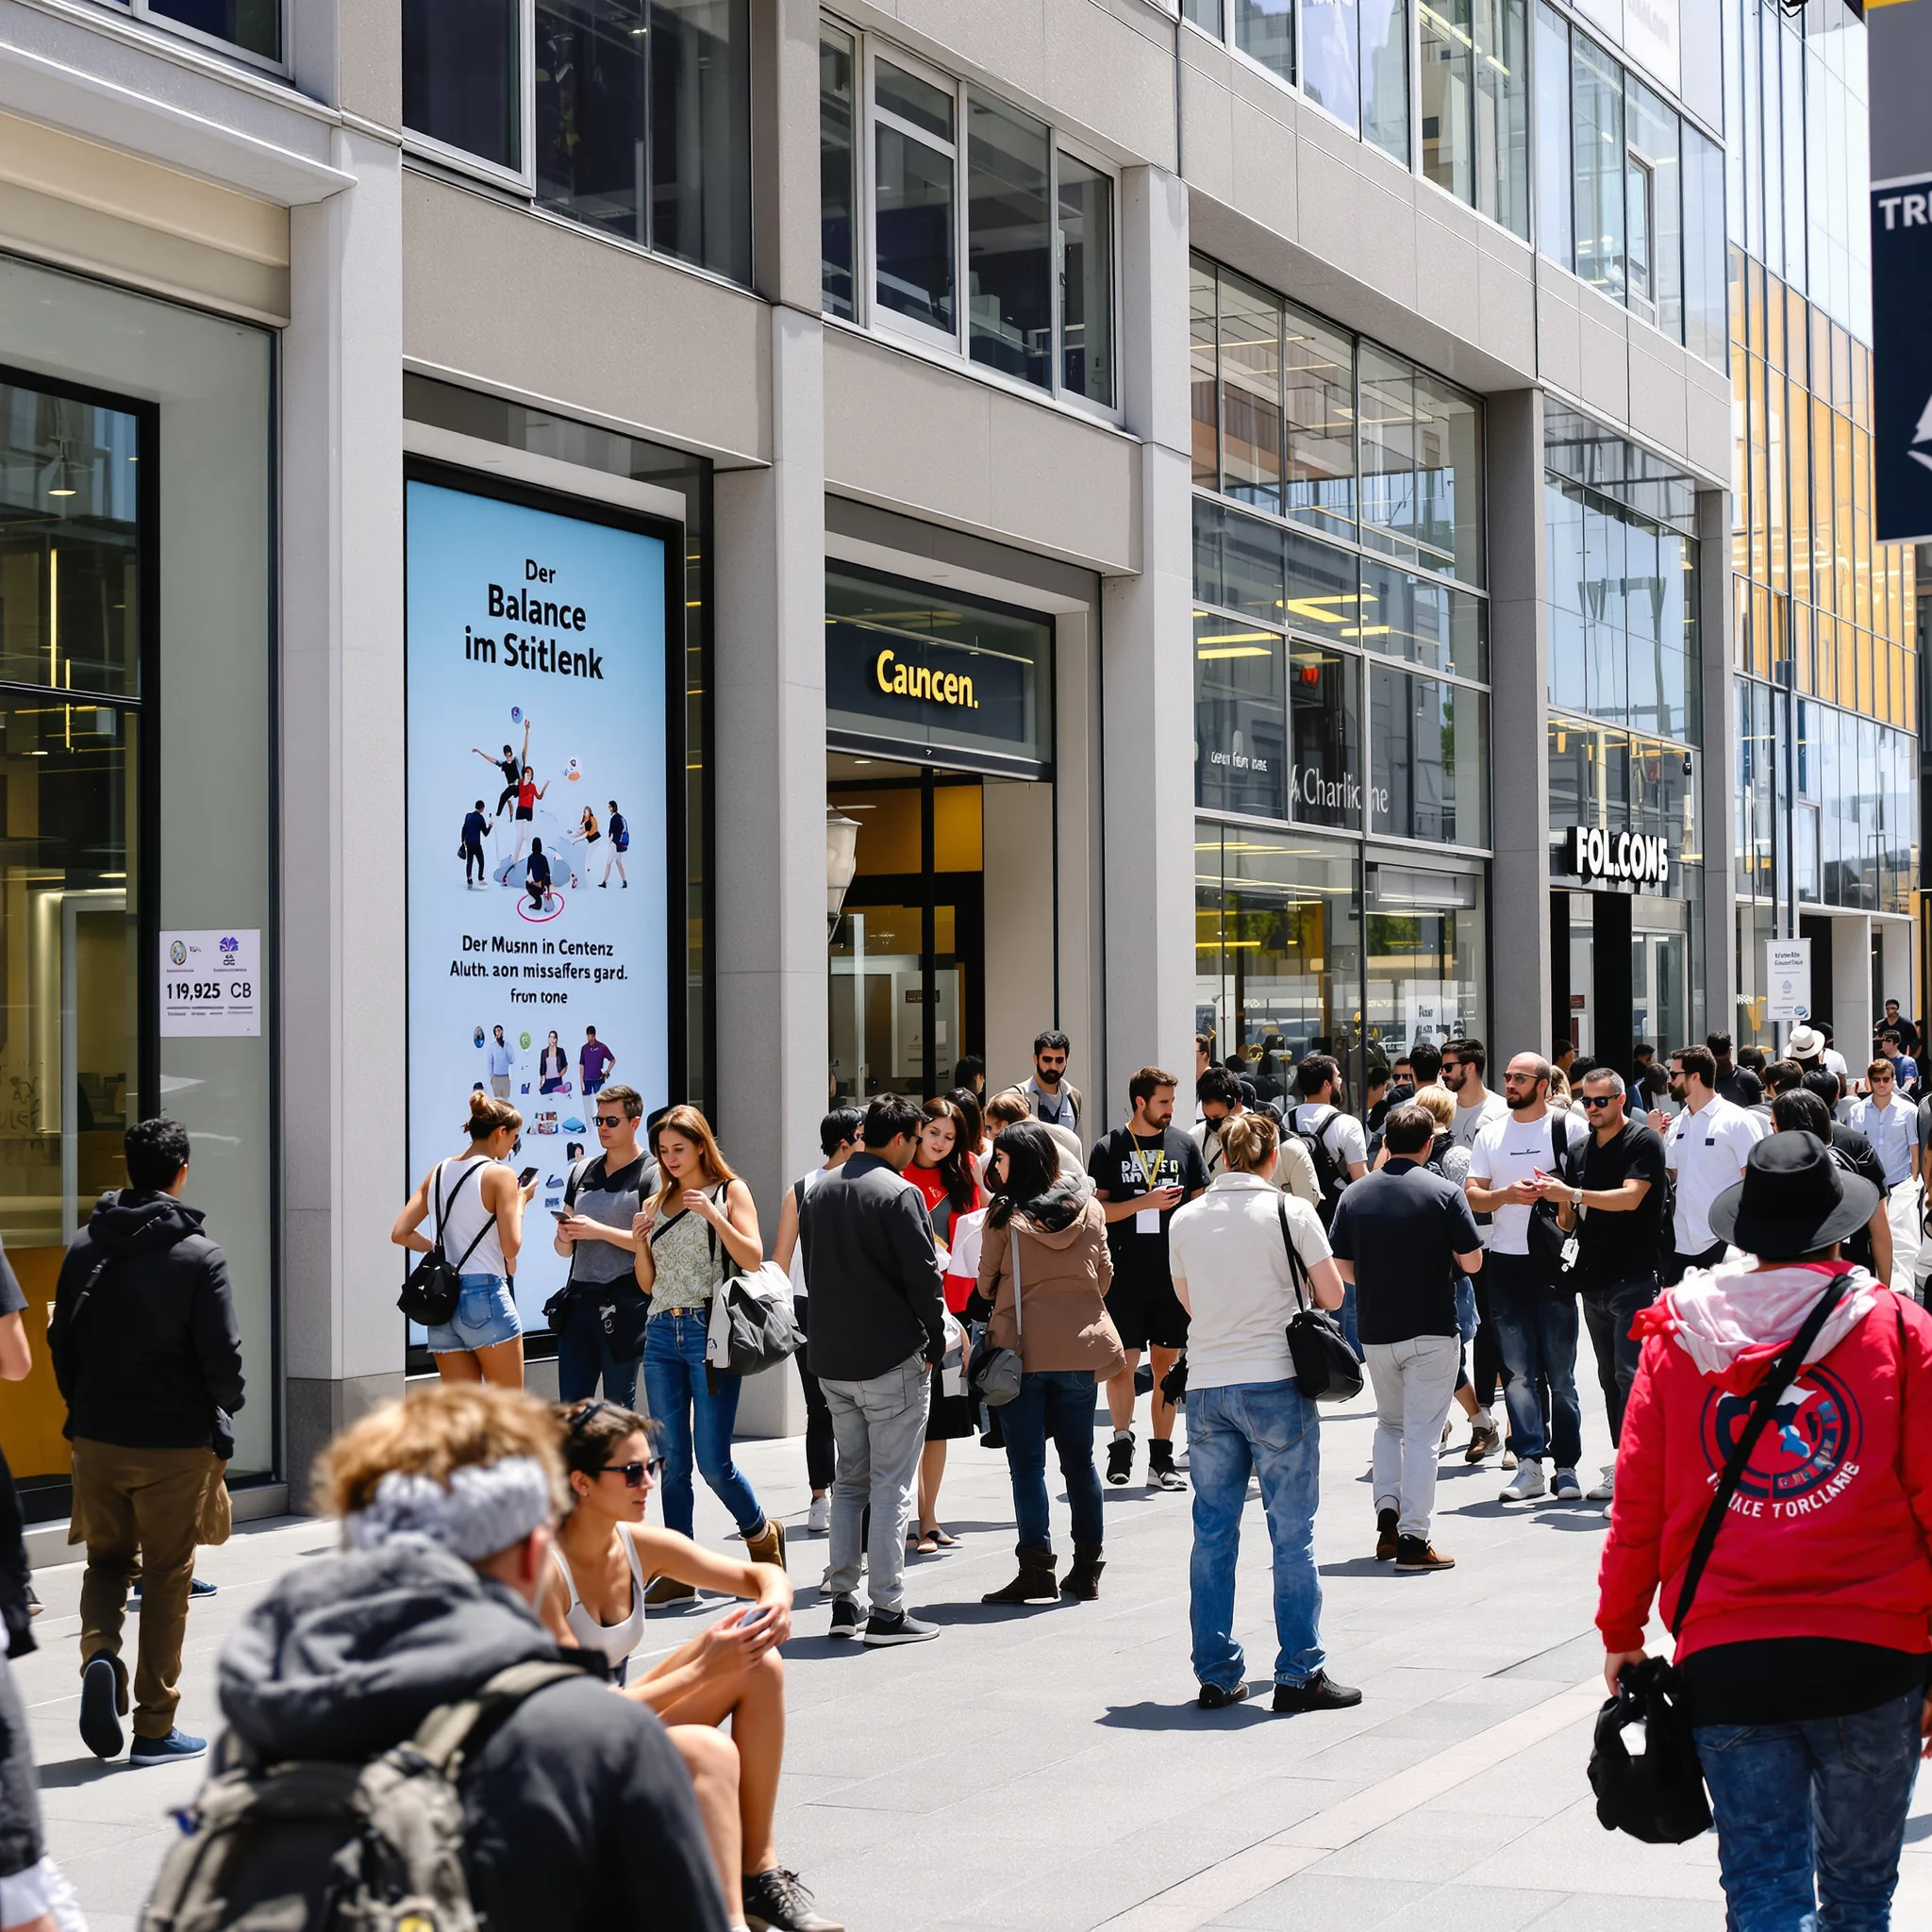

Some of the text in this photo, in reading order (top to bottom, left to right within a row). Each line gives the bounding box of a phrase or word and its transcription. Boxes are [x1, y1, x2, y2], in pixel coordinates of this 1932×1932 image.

[525, 558, 557, 584] Der
[488, 583, 587, 632] Balance
[465, 625, 604, 680] im Stitlenk
[462, 935, 488, 952] Der
[542, 938, 555, 955] in
[558, 939, 613, 956] Centenz
[492, 964, 518, 977] aon
[230, 982, 252, 998] CB
[541, 991, 568, 1004] tone
